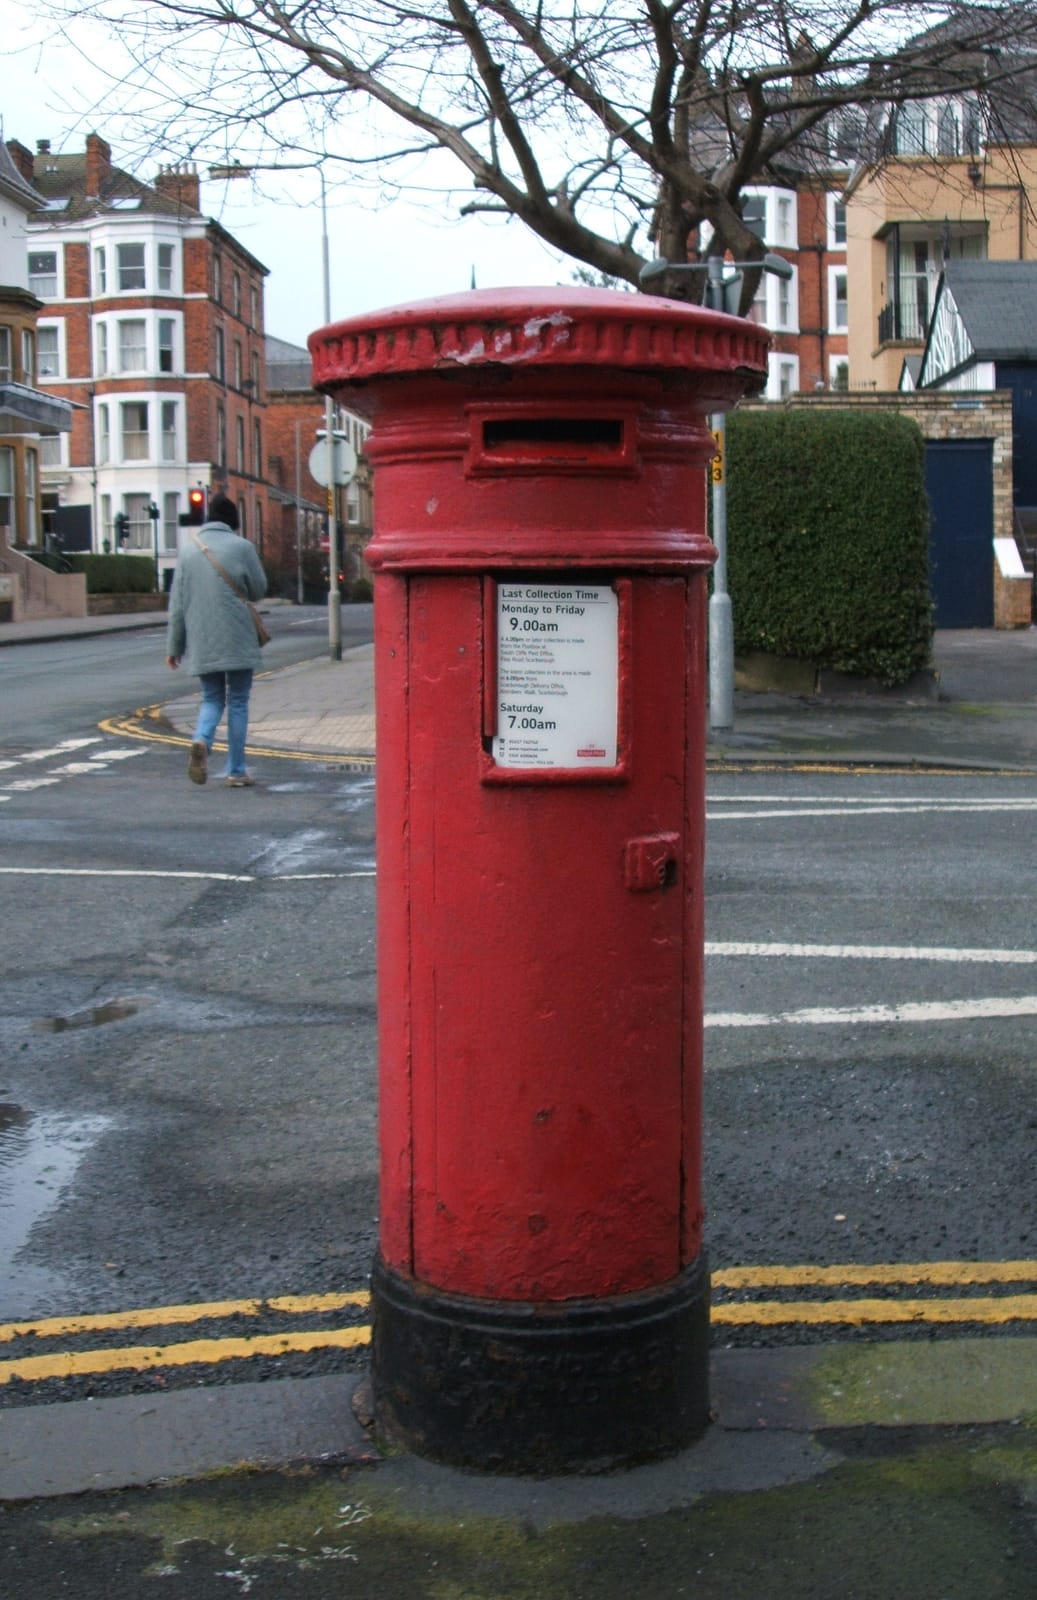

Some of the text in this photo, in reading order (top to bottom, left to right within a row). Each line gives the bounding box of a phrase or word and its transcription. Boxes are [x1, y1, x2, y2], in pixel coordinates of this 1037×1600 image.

[502, 588, 599, 599] Last Collection Time
[502, 604, 585, 616] Monday to Friday
[510, 617, 558, 631] 9.00am
[500, 703, 544, 714] Saturday
[508, 715, 556, 729] 7.00am
